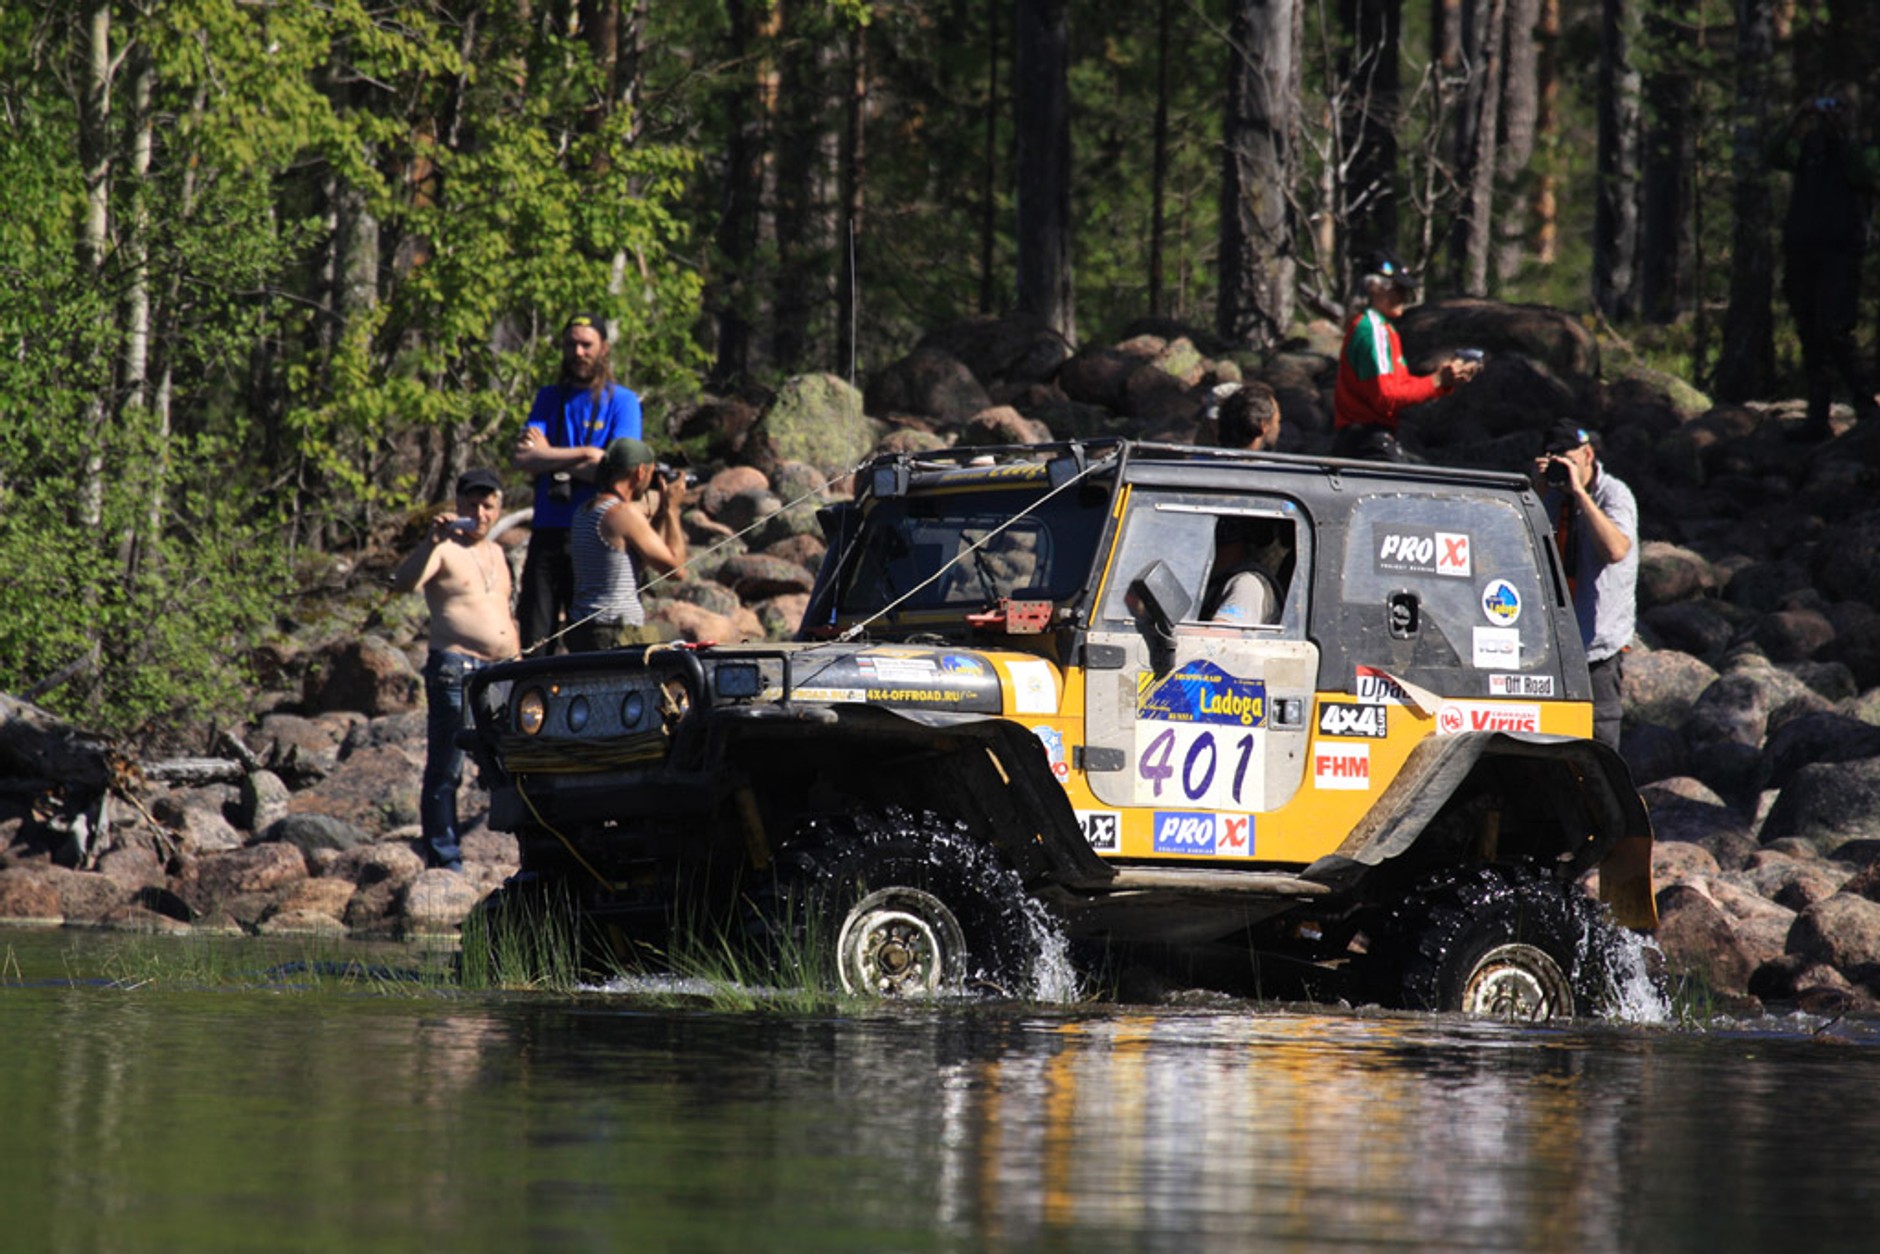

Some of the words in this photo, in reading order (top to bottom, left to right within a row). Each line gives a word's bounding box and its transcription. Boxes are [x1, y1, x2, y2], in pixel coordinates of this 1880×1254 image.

[1380, 534, 1434, 564] PRO
[1439, 537, 1467, 567] X
[1505, 675, 1521, 693] Off
[1524, 677, 1550, 694] Road
[1200, 687, 1263, 725] Ladoga
[1138, 728, 1255, 804] 401
[1316, 755, 1369, 778] FHM
[1159, 816, 1214, 846] PRO
[1218, 817, 1248, 848] X
